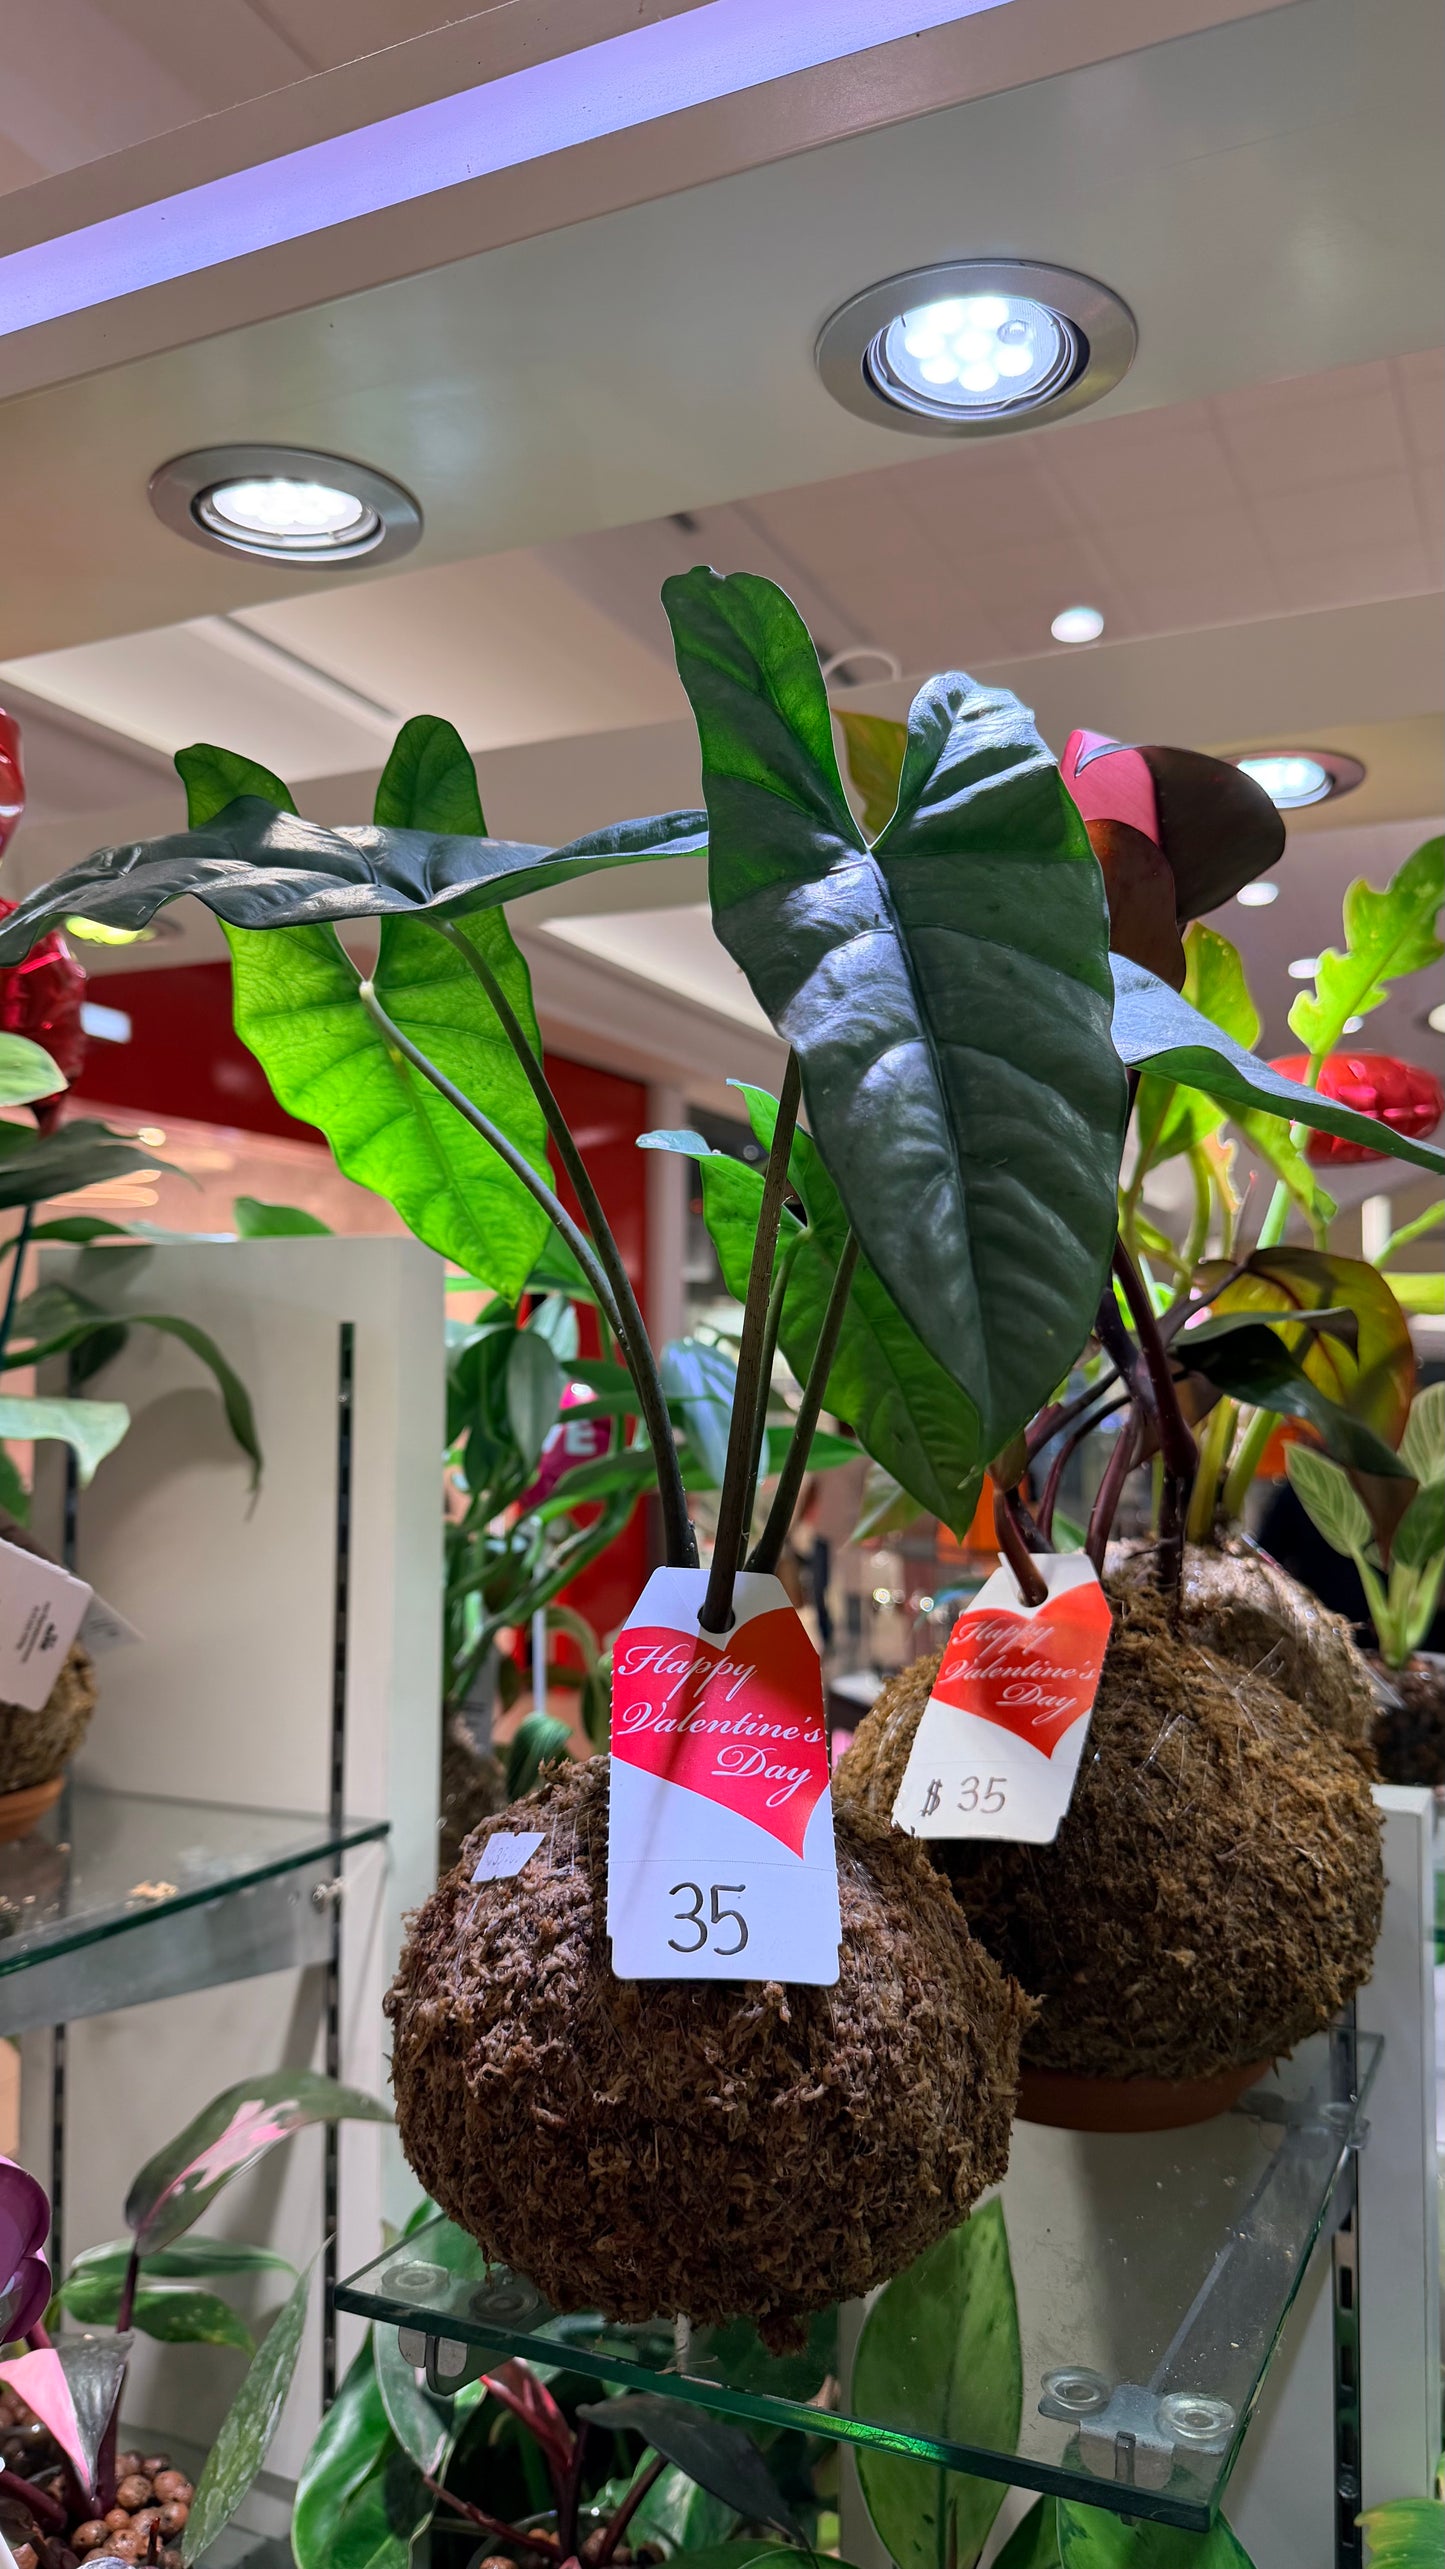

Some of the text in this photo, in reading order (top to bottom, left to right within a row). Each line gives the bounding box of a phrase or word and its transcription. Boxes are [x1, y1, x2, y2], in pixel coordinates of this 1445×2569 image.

[952, 1618, 1055, 1658] Happy
[618, 1643, 756, 1701] Happy
[938, 1655, 1096, 1684] Valentine's
[617, 1702, 824, 1743] Valentine's
[996, 1682, 1078, 1726] Day
[711, 1744, 812, 1808] Day
[957, 1776, 1008, 1814] 35
[667, 1881, 749, 1956] 35
